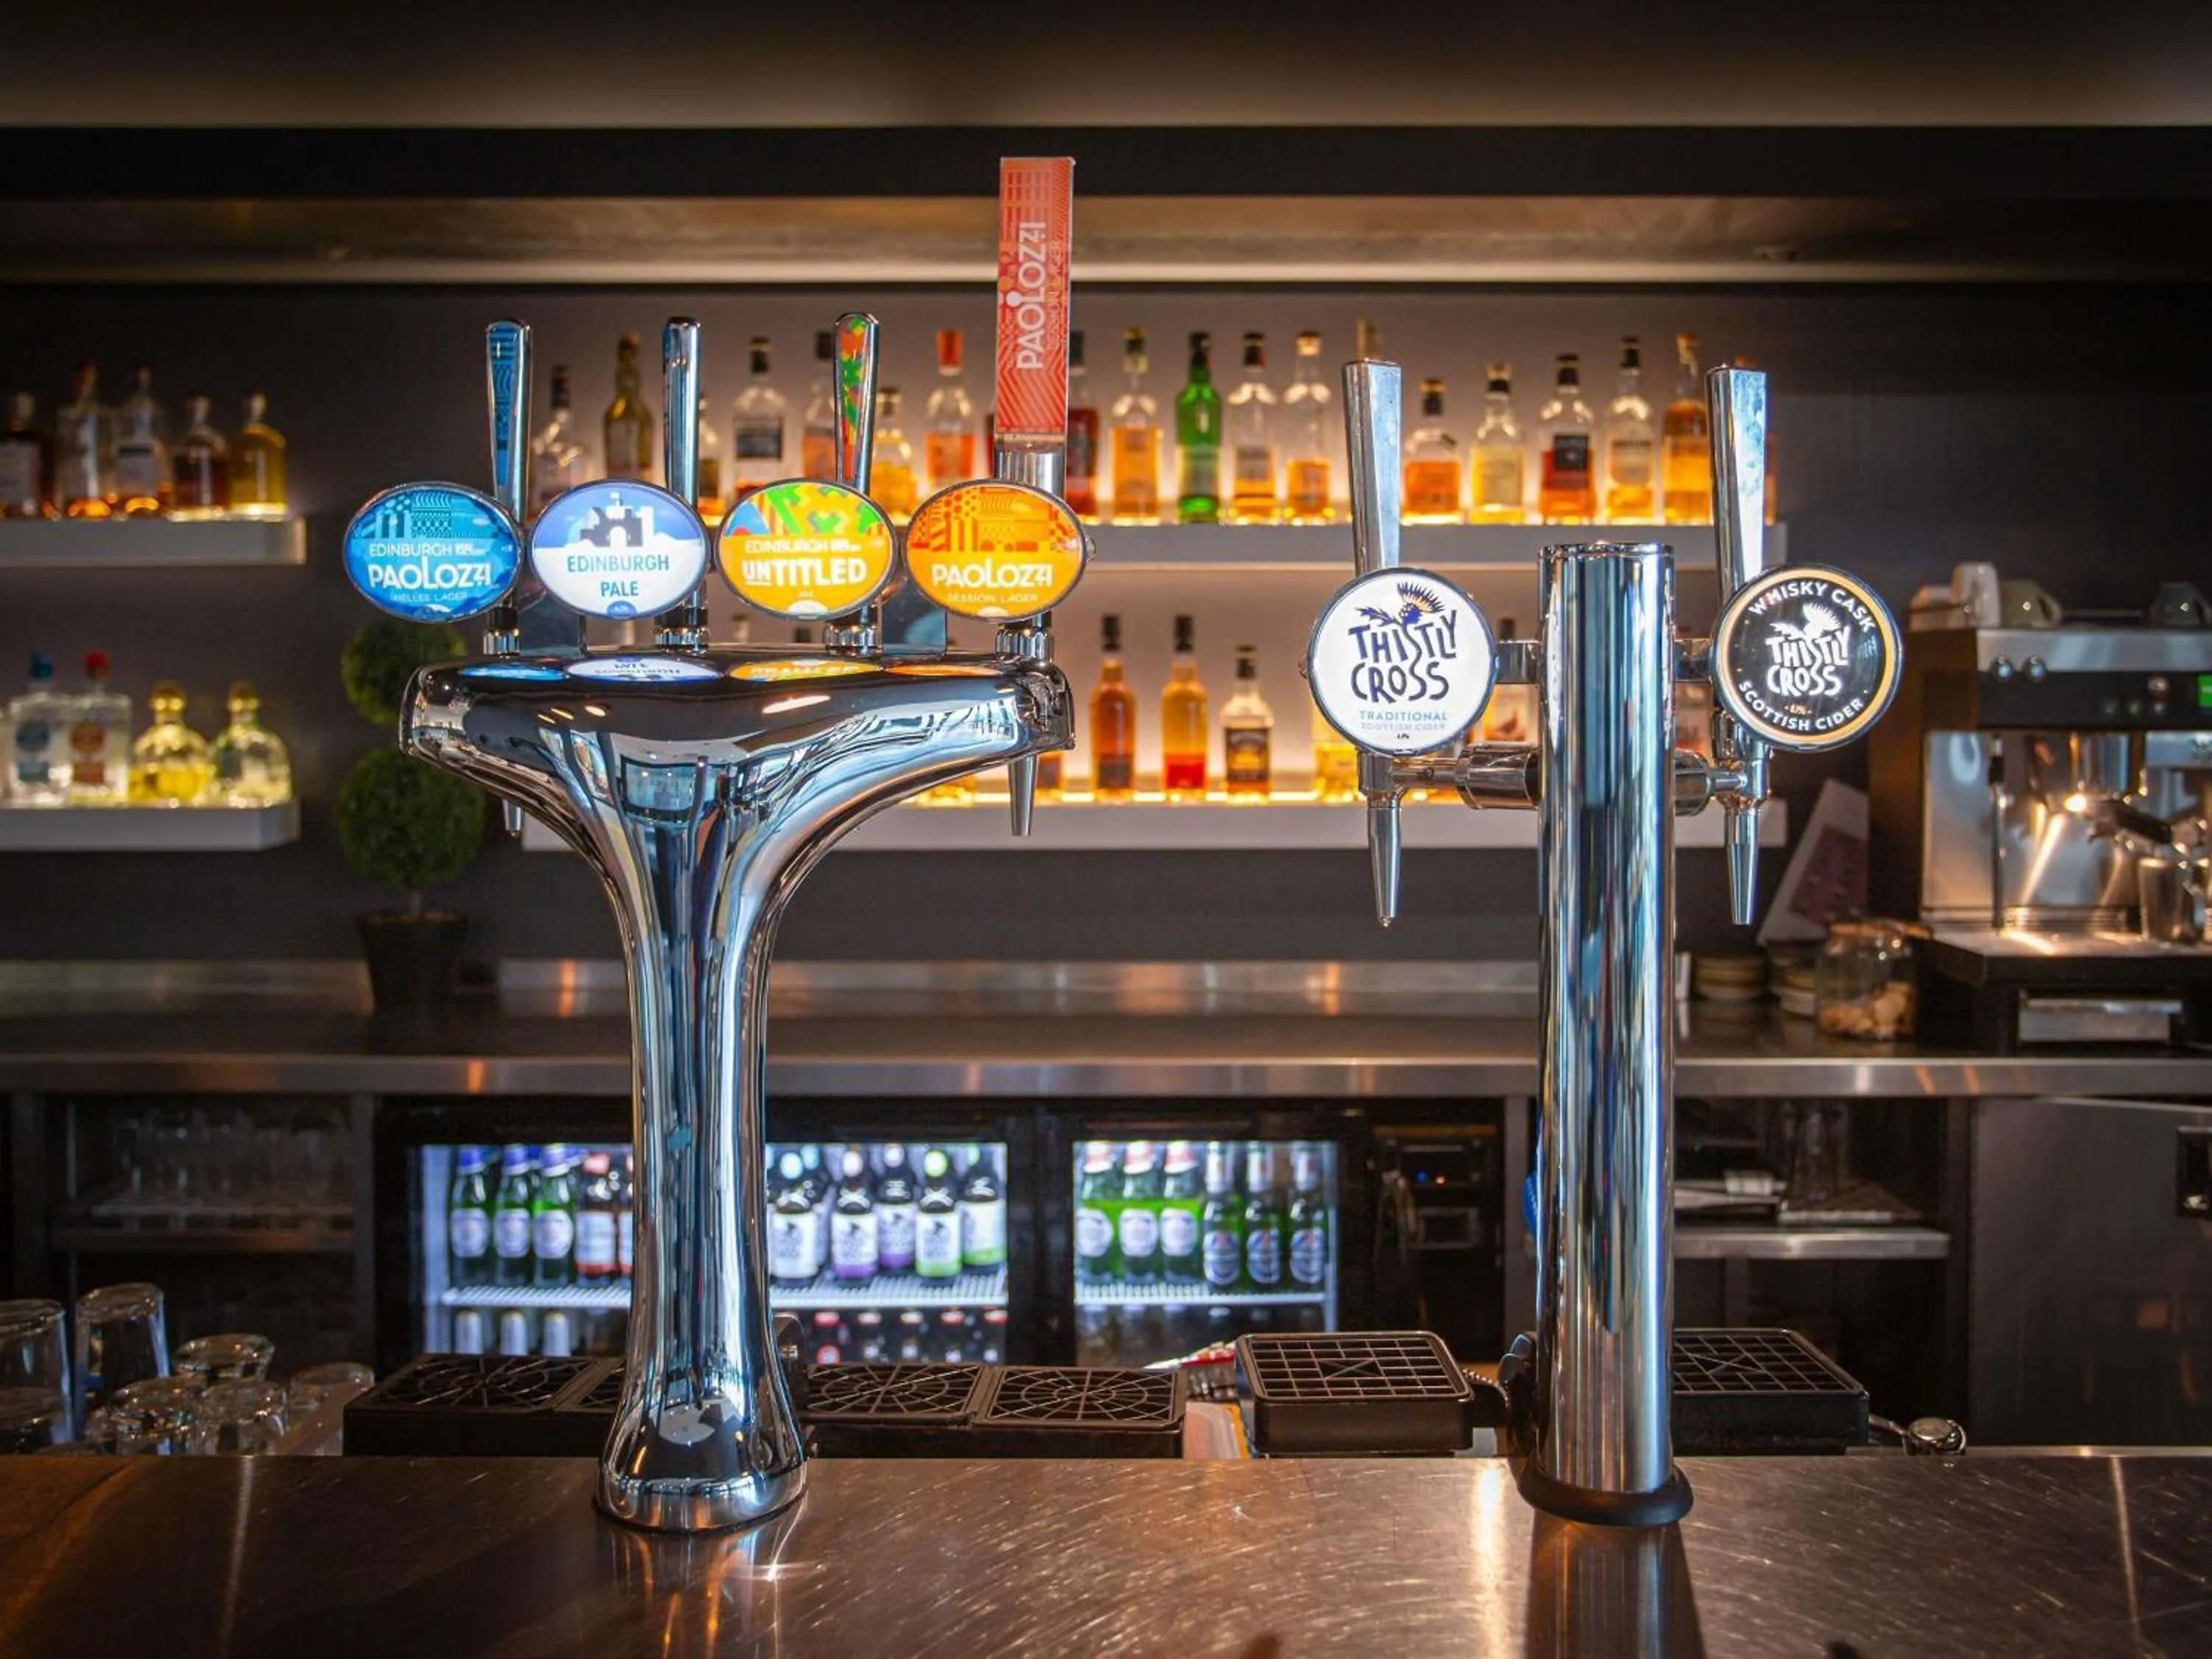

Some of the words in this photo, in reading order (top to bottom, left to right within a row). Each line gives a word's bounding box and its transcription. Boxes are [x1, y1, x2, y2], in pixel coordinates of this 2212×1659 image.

[1006, 222, 1046, 369] PAOLOZZI
[369, 543, 452, 557] EDINBURGH
[567, 554, 669, 572] EDINBURGH
[368, 556, 491, 589] PAOLOZZI
[742, 557, 867, 586] UNTITLED
[932, 557, 1053, 588] PAOLOZZI
[600, 580, 639, 597] PALE
[1748, 581, 1829, 616] WHISKY
[1831, 589, 1877, 633] CASK
[1348, 609, 1457, 663] THISTLY
[1765, 625, 1851, 667] THISTLY
[1350, 661, 1450, 703] CROSS
[1767, 664, 1843, 697] CROSS
[1359, 710, 1448, 721] TRADITIONAL
[1739, 681, 1810, 731] SCOTTISH
[1815, 697, 1865, 730] CIDER
